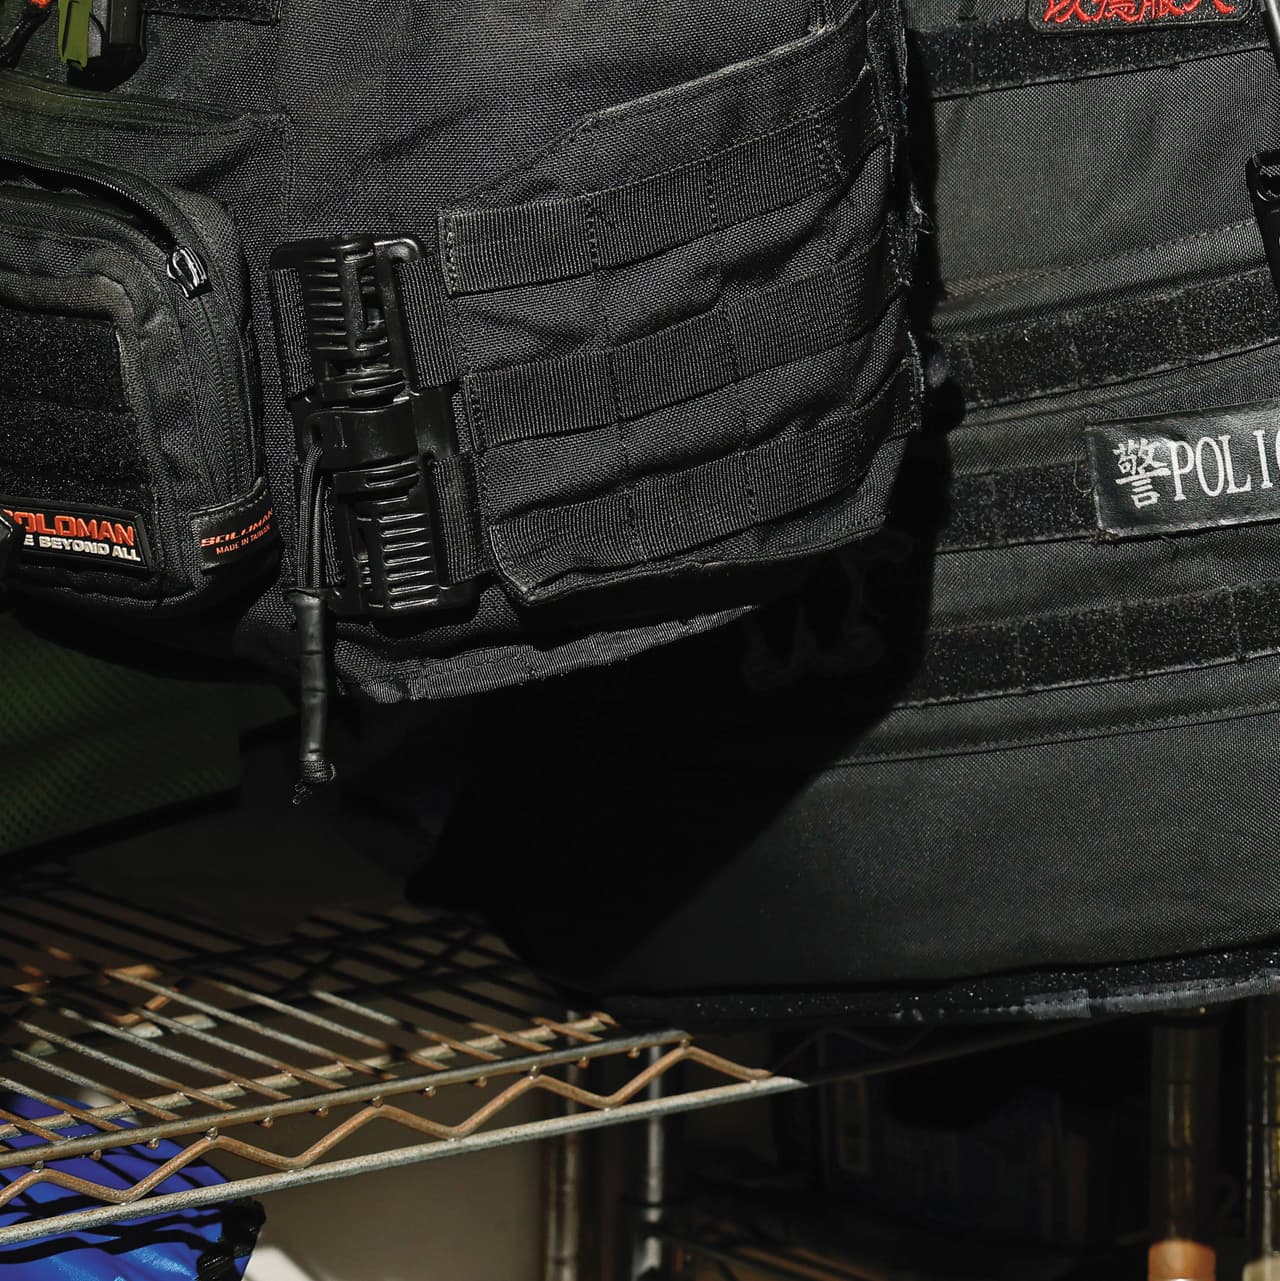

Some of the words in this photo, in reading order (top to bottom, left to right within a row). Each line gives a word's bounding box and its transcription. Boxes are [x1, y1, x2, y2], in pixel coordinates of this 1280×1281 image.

[2, 509, 135, 547] OLOMAN
[39, 536, 110, 556] BEYOND
[111, 545, 142, 562] ALL
[215, 542, 241, 556] MADE
[241, 537, 249, 547] IN
